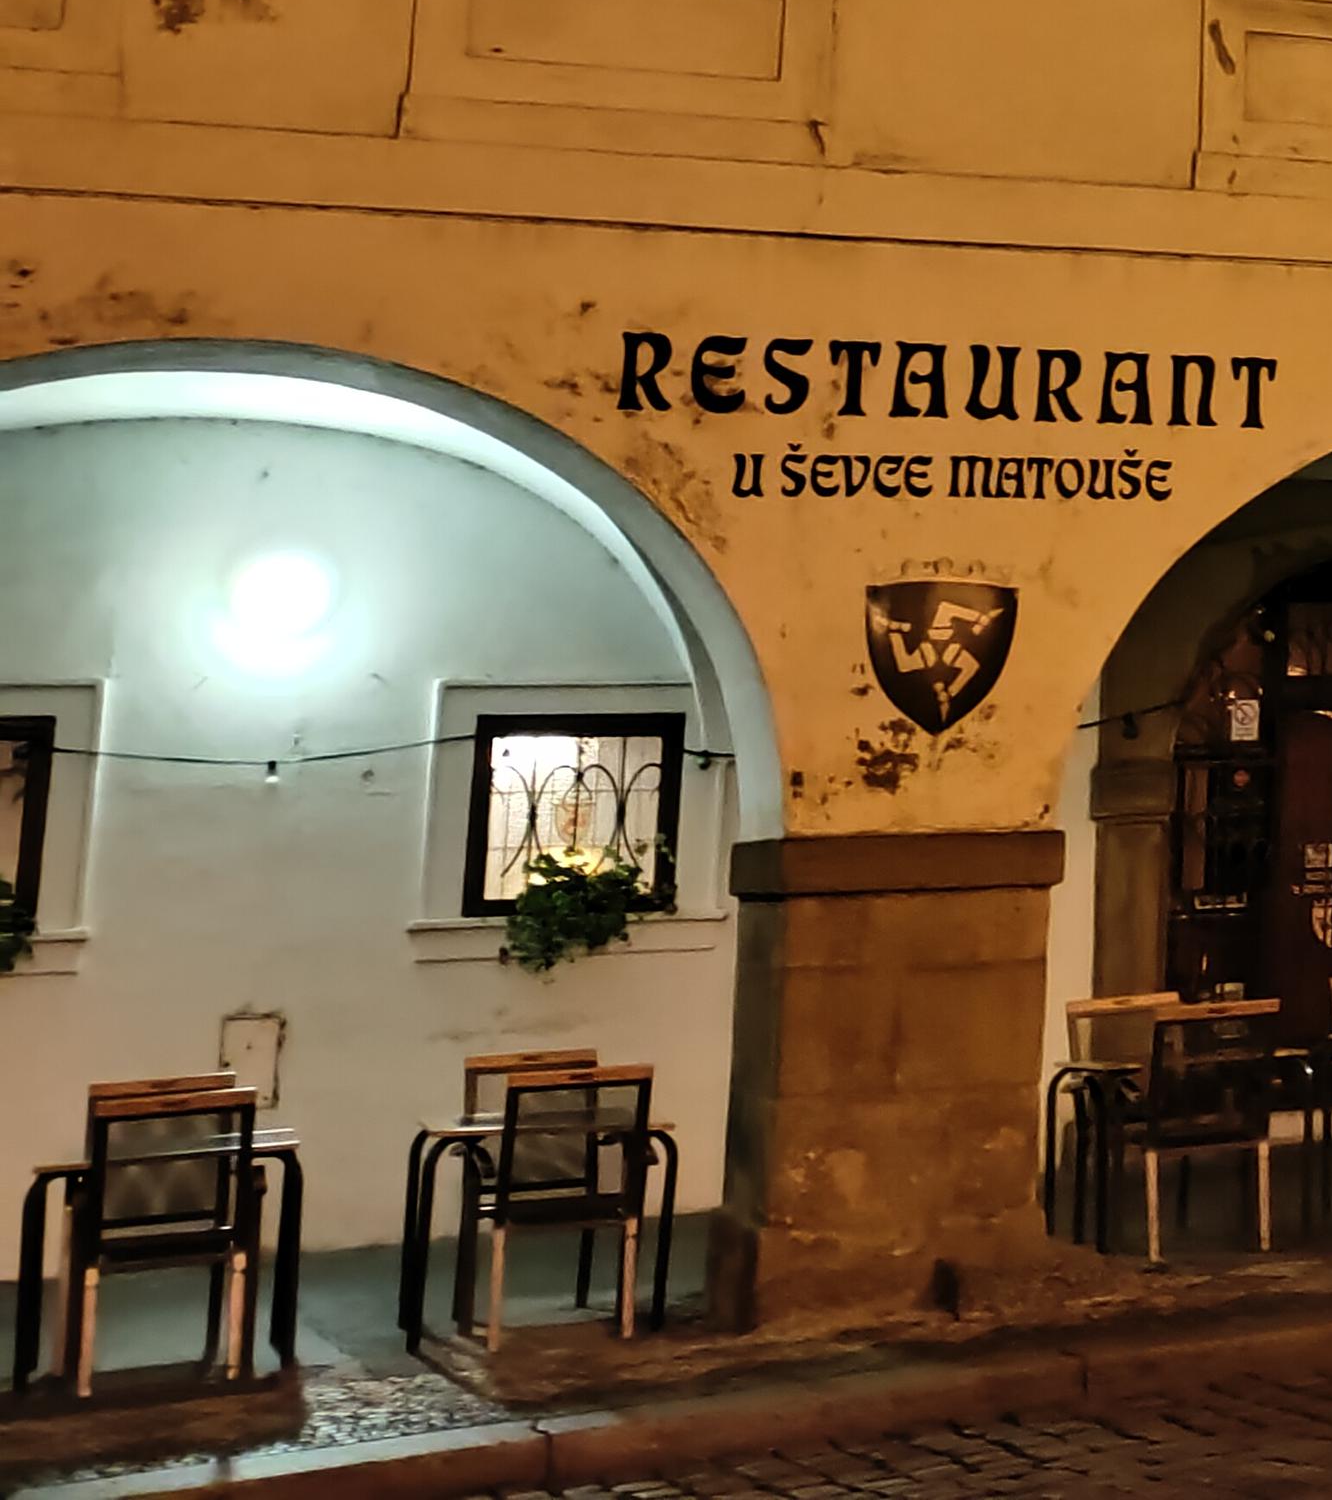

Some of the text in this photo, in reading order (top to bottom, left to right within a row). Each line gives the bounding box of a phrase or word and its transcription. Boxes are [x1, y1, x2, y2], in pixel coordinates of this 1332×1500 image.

[616, 331, 1278, 430] RESTAURANT
[731, 443, 1174, 502] U ŠEVCE MATOUŠE
